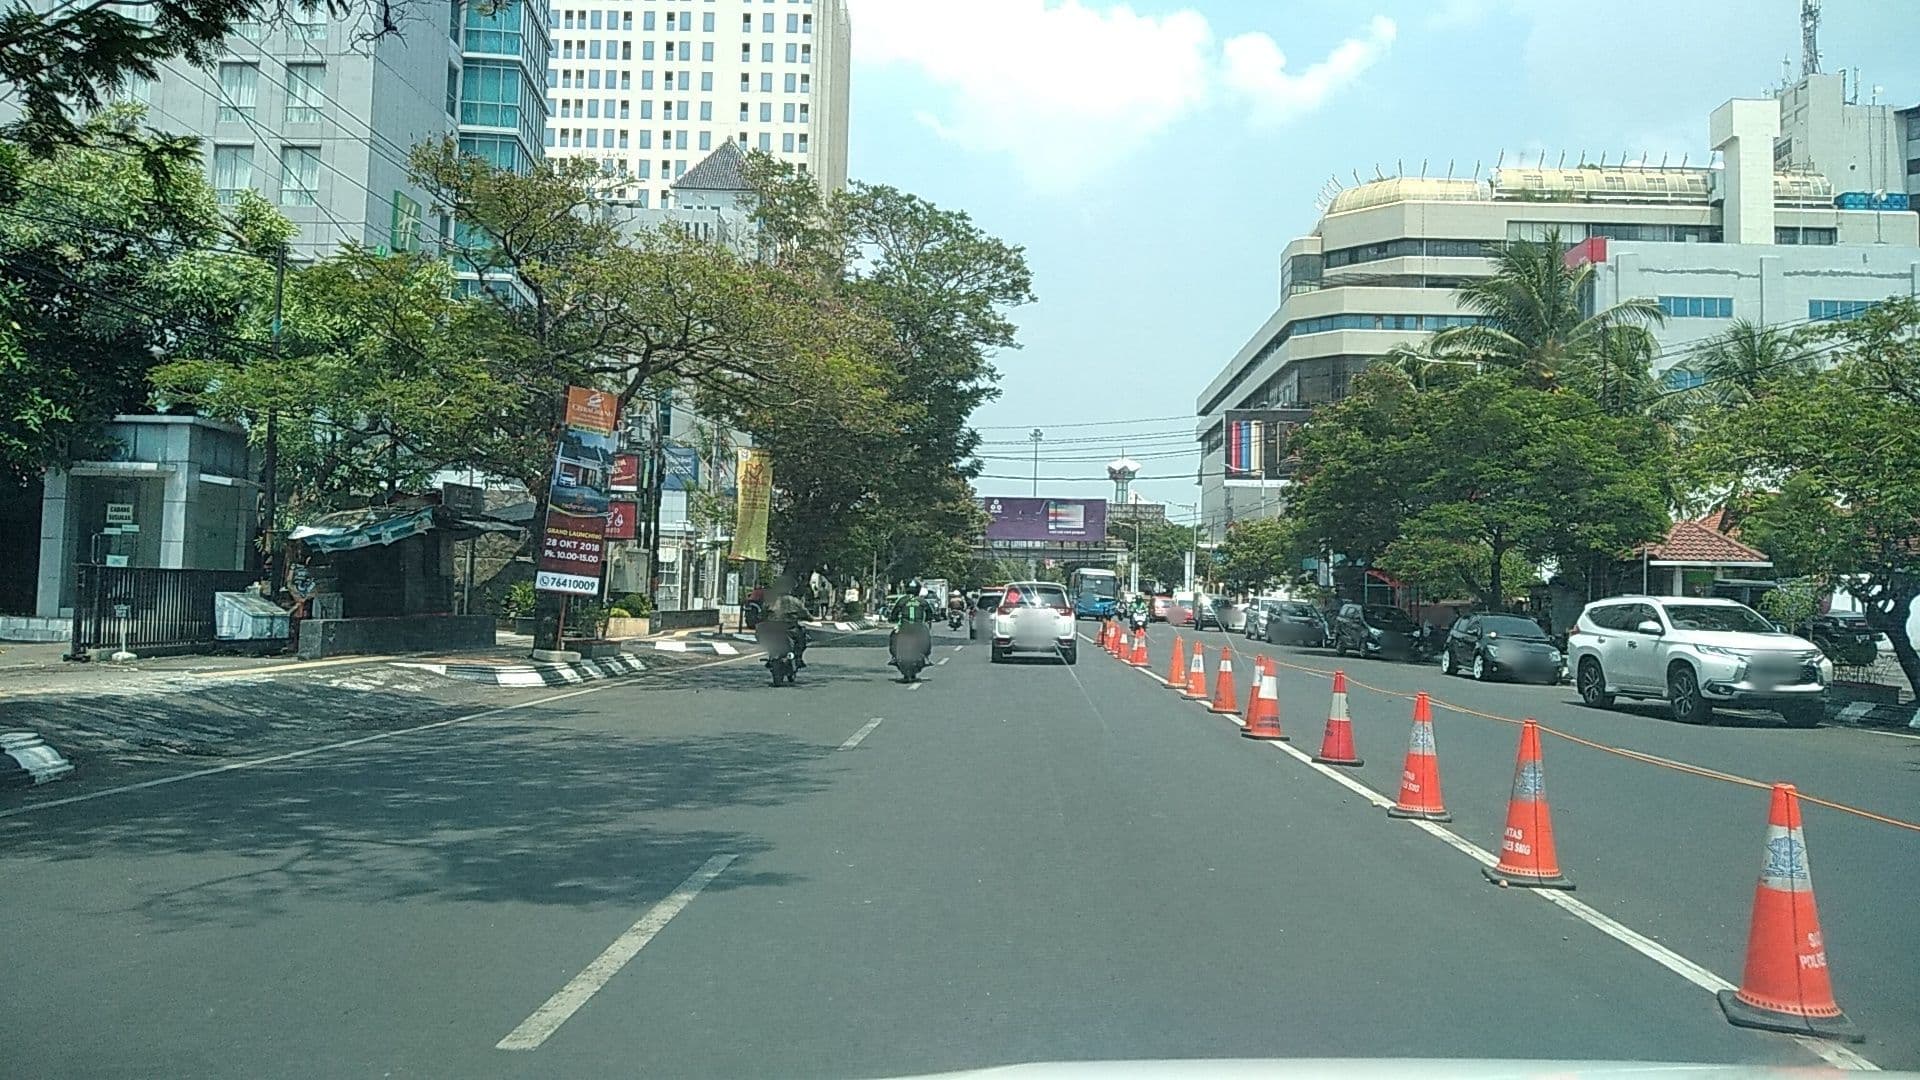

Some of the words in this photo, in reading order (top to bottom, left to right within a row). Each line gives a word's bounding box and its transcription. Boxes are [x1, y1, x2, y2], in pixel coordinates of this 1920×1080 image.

[547, 528, 568, 536] GRAND
[568, 530, 602, 540] LAUNCHING
[546, 538, 557, 547] 28
[559, 540, 578, 549] OKT
[580, 543, 600, 552] 2018
[556, 551, 599, 563] 10.00-15.00
[550, 577, 596, 591] 76410009
